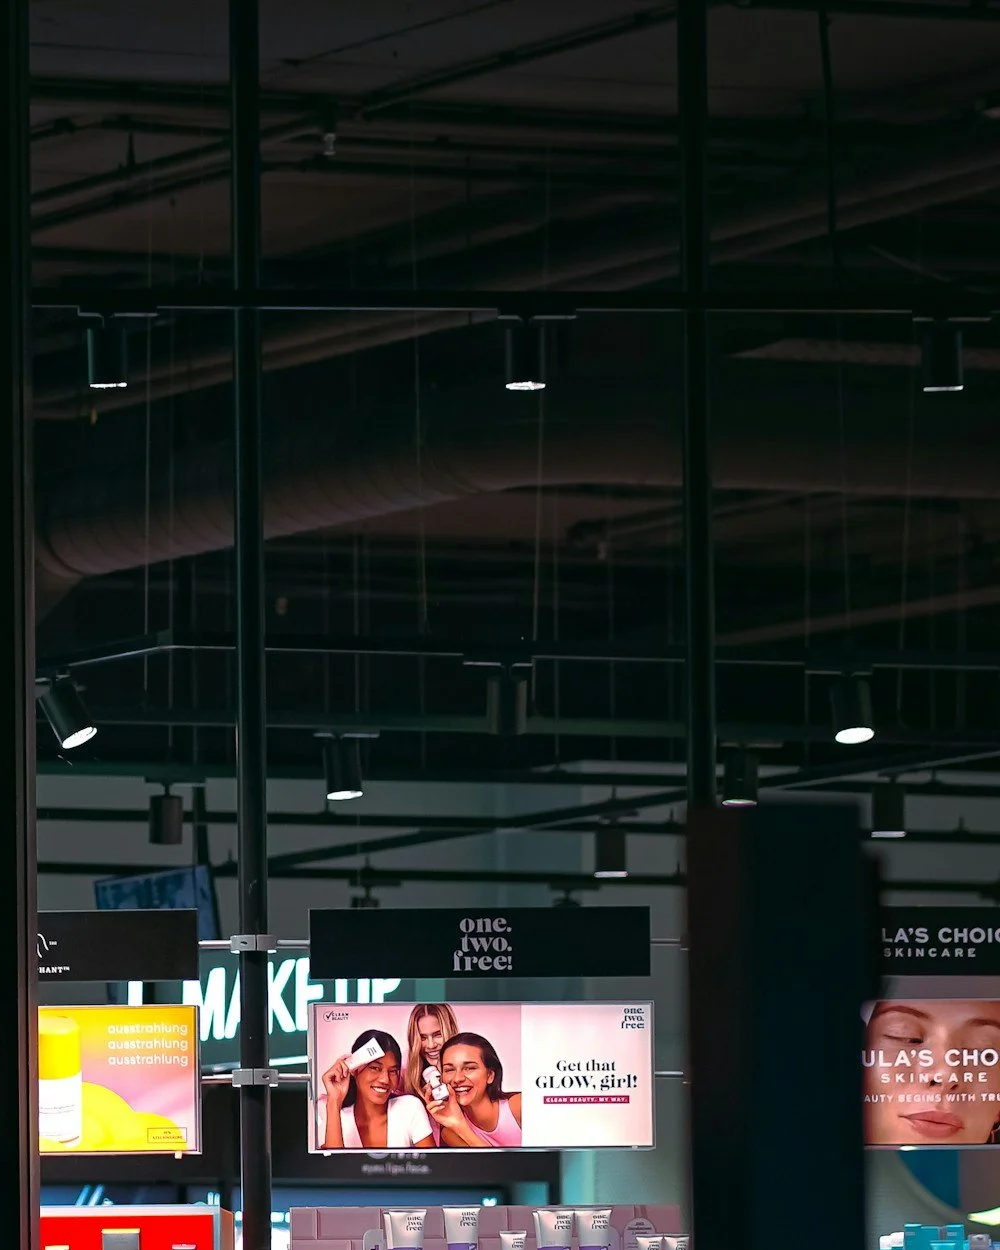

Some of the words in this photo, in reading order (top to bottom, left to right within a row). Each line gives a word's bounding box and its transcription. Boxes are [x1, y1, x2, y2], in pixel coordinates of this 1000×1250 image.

[459, 917, 512, 933] one.
[460, 934, 512, 952] two.
[883, 948, 977, 958] SKINCARE
[453, 950, 513, 971] free!
[107, 1023, 188, 1036] ausstrahlung
[107, 1039, 188, 1051] ausstrahlung
[107, 1054, 188, 1067] ausstrahlung
[556, 1060, 582, 1072] Get
[585, 1059, 616, 1072] that
[535, 1075, 596, 1089] GLOW,
[600, 1074, 638, 1091] girl!
[881, 1072, 988, 1084] SKINCARE
[898, 1094, 942, 1103] BEGINS
[945, 1094, 975, 1102] WITH
